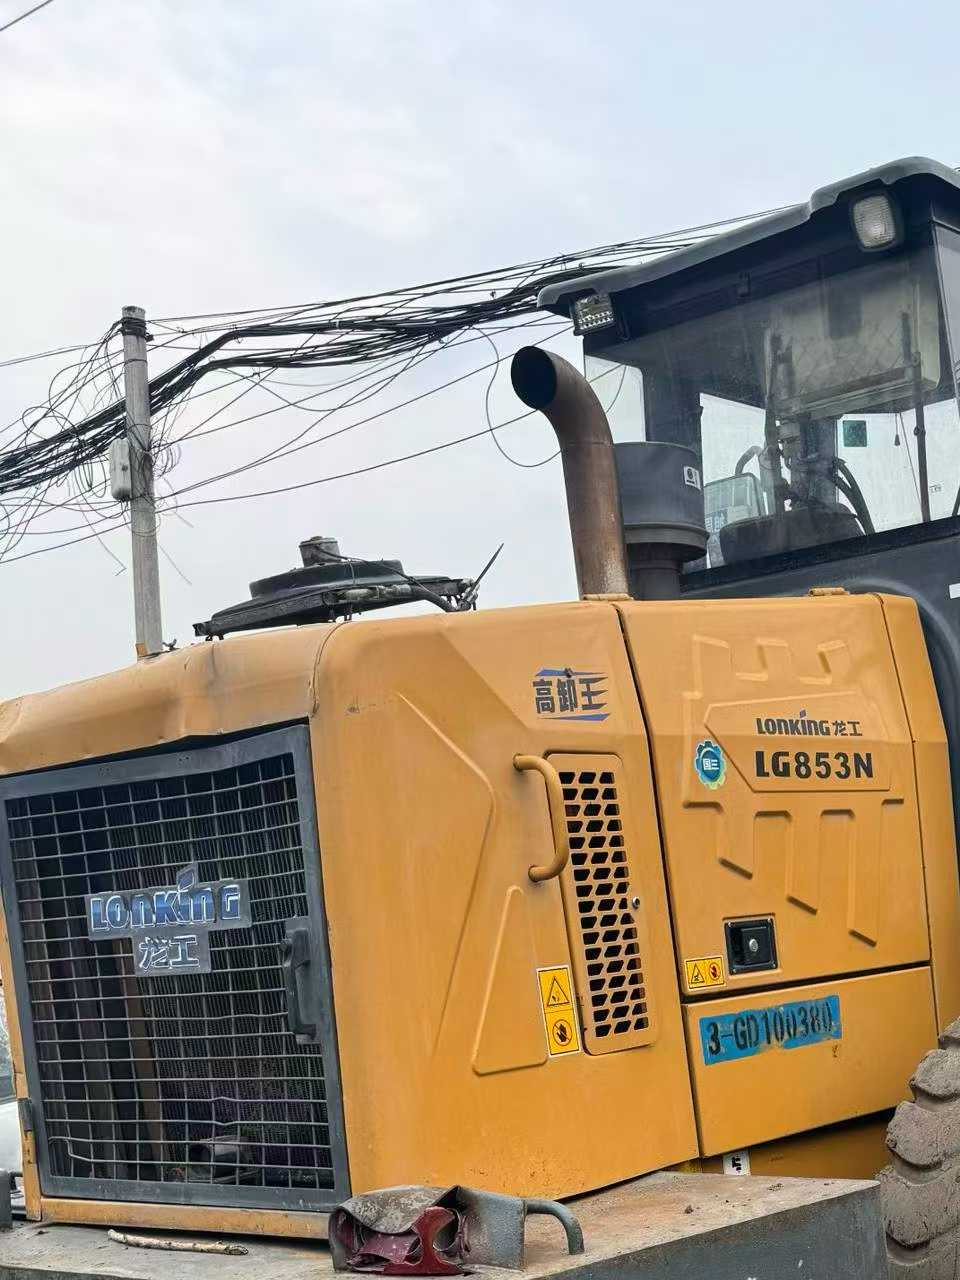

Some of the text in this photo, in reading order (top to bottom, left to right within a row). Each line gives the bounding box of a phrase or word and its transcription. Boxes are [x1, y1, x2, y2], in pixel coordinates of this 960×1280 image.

[532, 676, 608, 714] 高卸王
[755, 750, 874, 779] LG853N
[138, 934, 200, 972] 龙工
